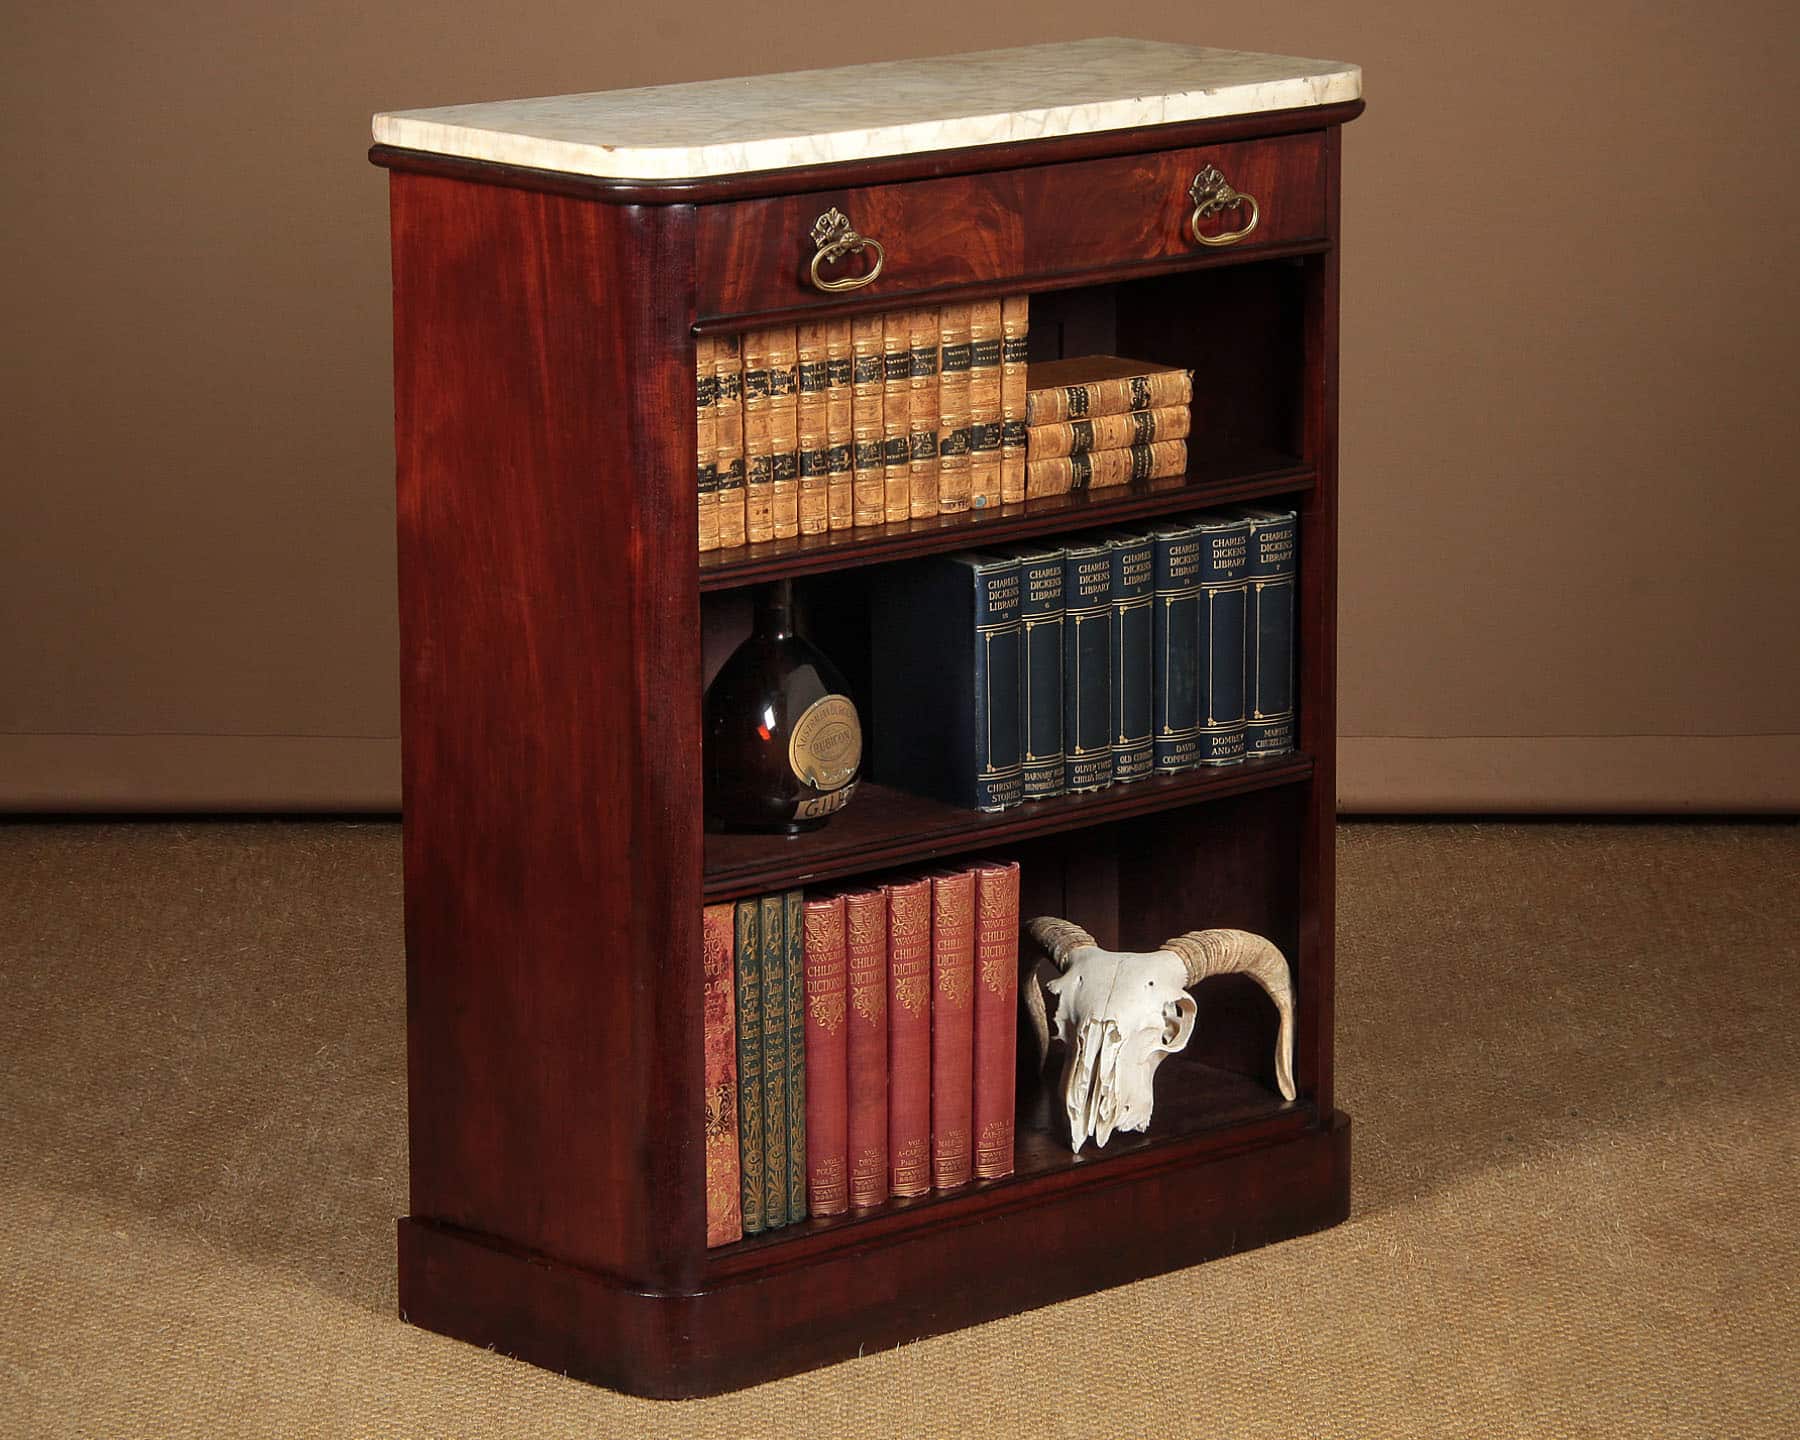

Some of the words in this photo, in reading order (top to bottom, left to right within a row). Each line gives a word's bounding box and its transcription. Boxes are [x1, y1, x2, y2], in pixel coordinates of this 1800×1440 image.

[1212, 536, 1246, 548] CHARLES
[1260, 530, 1293, 542] CHARLES
[1169, 543, 1199, 555] CHARLES
[1213, 546, 1246, 559] DICKENS
[1261, 540, 1293, 553] DICKENS
[1122, 551, 1151, 565] CHARLES
[1170, 553, 1199, 567] DICKENS
[1213, 557, 1246, 570] LIBRARY
[1261, 551, 1293, 564] LIBRARY
[1030, 567, 1061, 579] CHARLES
[1078, 560, 1110, 573] CHARLES
[1123, 561, 1151, 575] DICKENS
[1170, 564, 1199, 577] LIBRARY
[988, 576, 1018, 590] CHARLES
[1030, 577, 1062, 590] DICKENS
[1079, 571, 1110, 584] DICKENS
[1123, 572, 1151, 586] LIBRARY
[989, 586, 1019, 601] DICKENS
[1031, 588, 1062, 601] LIBRARY
[1080, 582, 1110, 596] LIBRARY
[989, 598, 1018, 612] LIBRARY
[1212, 733, 1245, 745] DOMBEY
[992, 789, 1021, 803] STORIES
